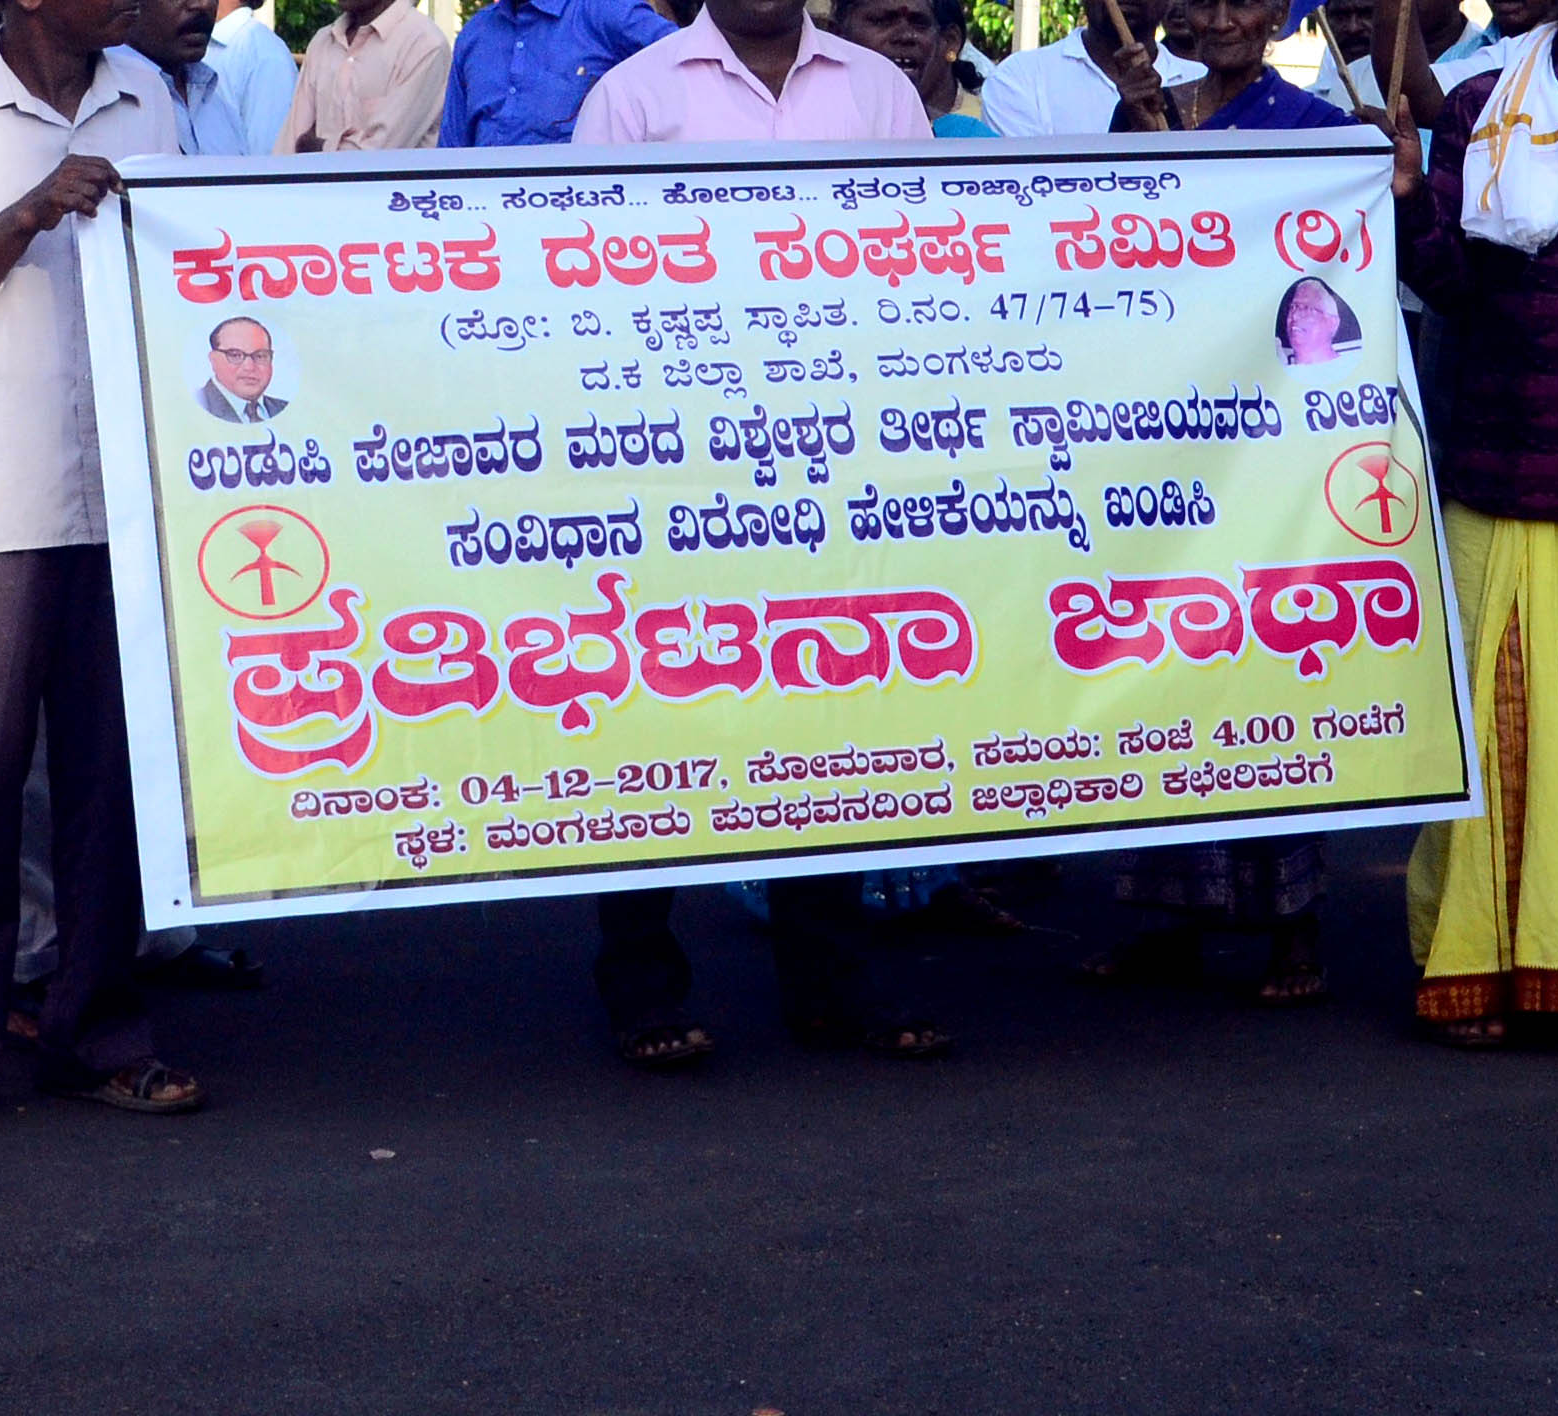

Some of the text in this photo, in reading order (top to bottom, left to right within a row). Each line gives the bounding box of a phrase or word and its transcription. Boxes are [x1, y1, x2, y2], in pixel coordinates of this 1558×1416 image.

[831, 175, 927, 211] ಸ್ವತಂತ್ರ
[172, 222, 501, 304] ಕರ್ನಾಟಕ
[540, 216, 718, 289] ದಲಿತ
[1049, 204, 1236, 271] ಸಮಿತಿ
[1273, 209, 1373, 273] (ರಿ.)
[570, 309, 612, 337] ಬಿ.
[631, 302, 731, 352] ಕೃಷ್ಣಪ್ಪ
[877, 294, 970, 325] ರಿ.ನಂ.
[579, 343, 1063, 400] ದ.ಕ ಜಿಲ್ಲಾ ಶಾಖೆ, ಮಂಗಳೂರು
[188, 429, 332, 491] ಉಡುಪಿ
[352, 415, 543, 483] ಪೇಜಾವರ
[565, 409, 685, 470] ಮಠದ
[708, 401, 856, 488] ವಿಶ್ವೇಶ್ವರ
[879, 396, 987, 460] ತೀರ್ಥ
[1304, 383, 1398, 432] ನೀಡಿ
[445, 474, 1216, 570] ಸಂವಿಧಾನ ವಿರೋಧಿ ಹೇಳಿಕೆಯನ್ನು ಖಂಡಿಸಿ
[226, 559, 1420, 774] ಪ್ರತಿಭಟನಾ ಜಾಥಾ
[290, 702, 1405, 819] ದಿನಾಂಕ: 04-12-2017, ಸೋಮವಾರ, ಸಮಯ: ಸಂಜೆ 4.00 ಗಂಟೆಗೆ
[394, 820, 467, 870] ಸ್ಥಳ:
[486, 804, 691, 850] ಮಂಗಳೂರು
[711, 778, 953, 833] ಪುರಭವನದಿಂದ
[971, 772, 1144, 819] ಜಿಲ್ಲಾಧಿಕಾರಿ
